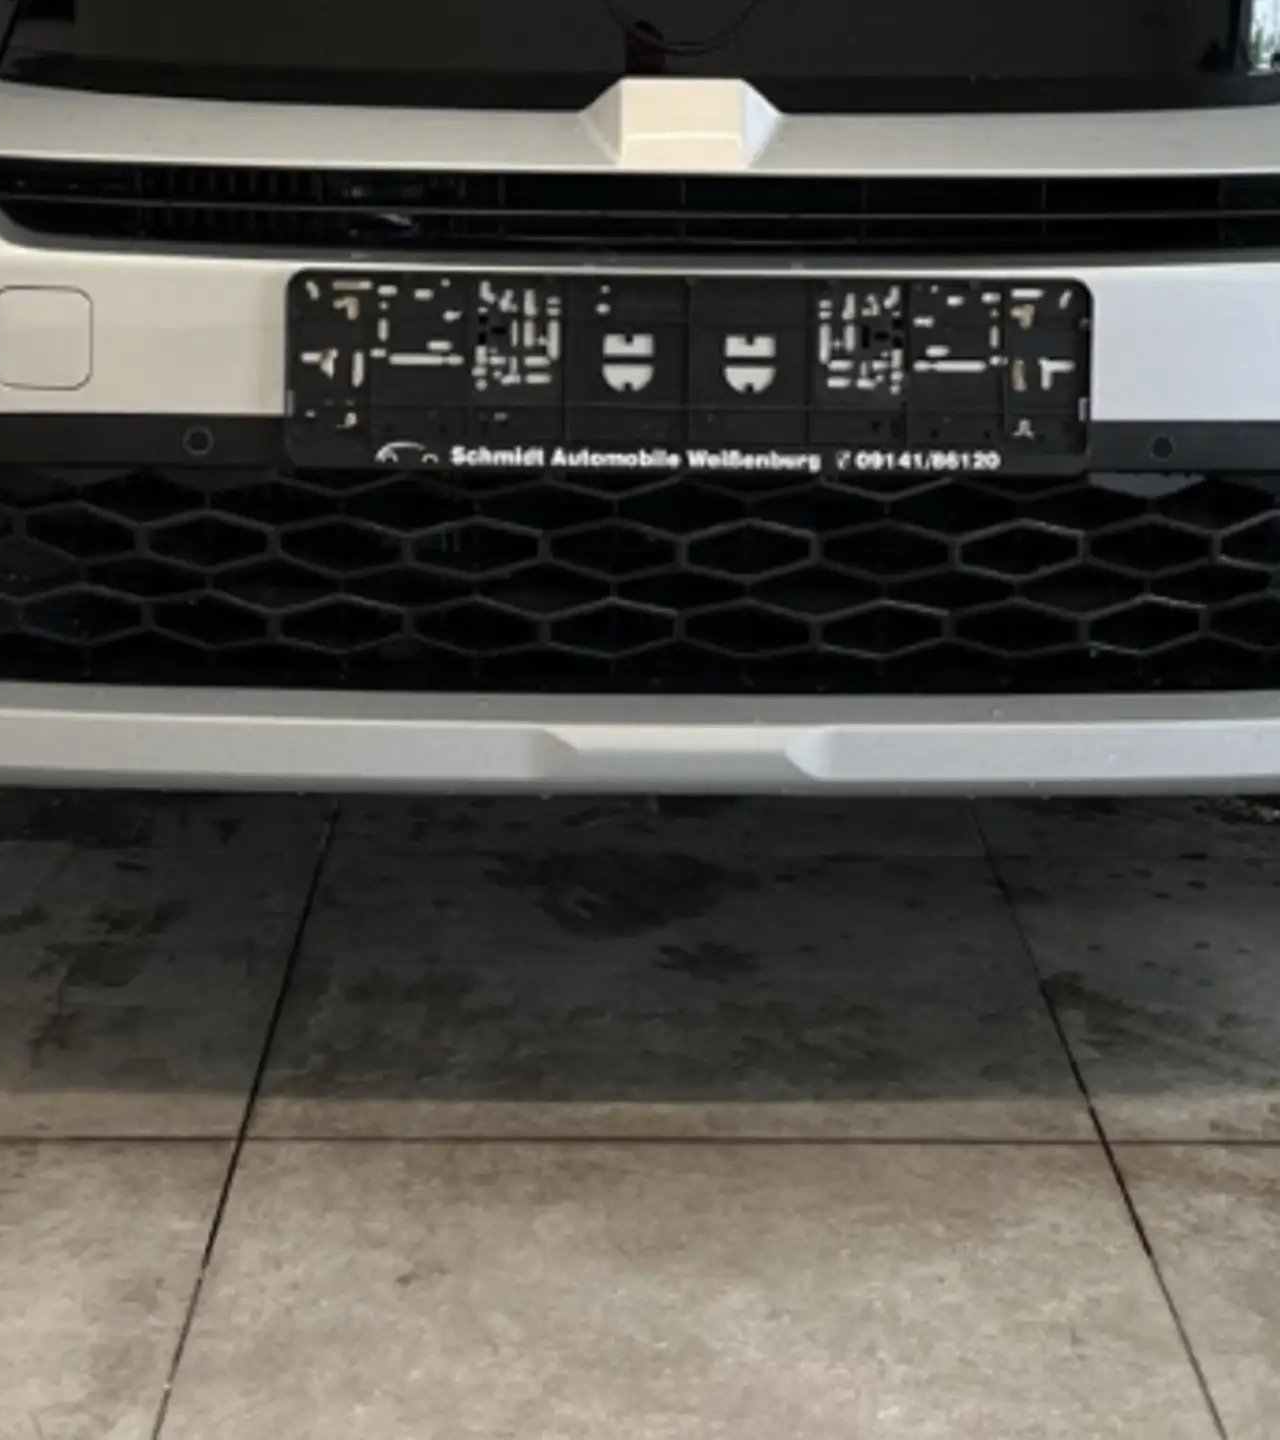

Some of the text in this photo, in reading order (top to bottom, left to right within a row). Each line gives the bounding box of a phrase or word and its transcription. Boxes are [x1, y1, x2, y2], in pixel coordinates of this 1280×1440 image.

[450, 445, 544, 467] Schmidt
[550, 446, 680, 467] Automobile
[686, 448, 821, 473] Weißenburg
